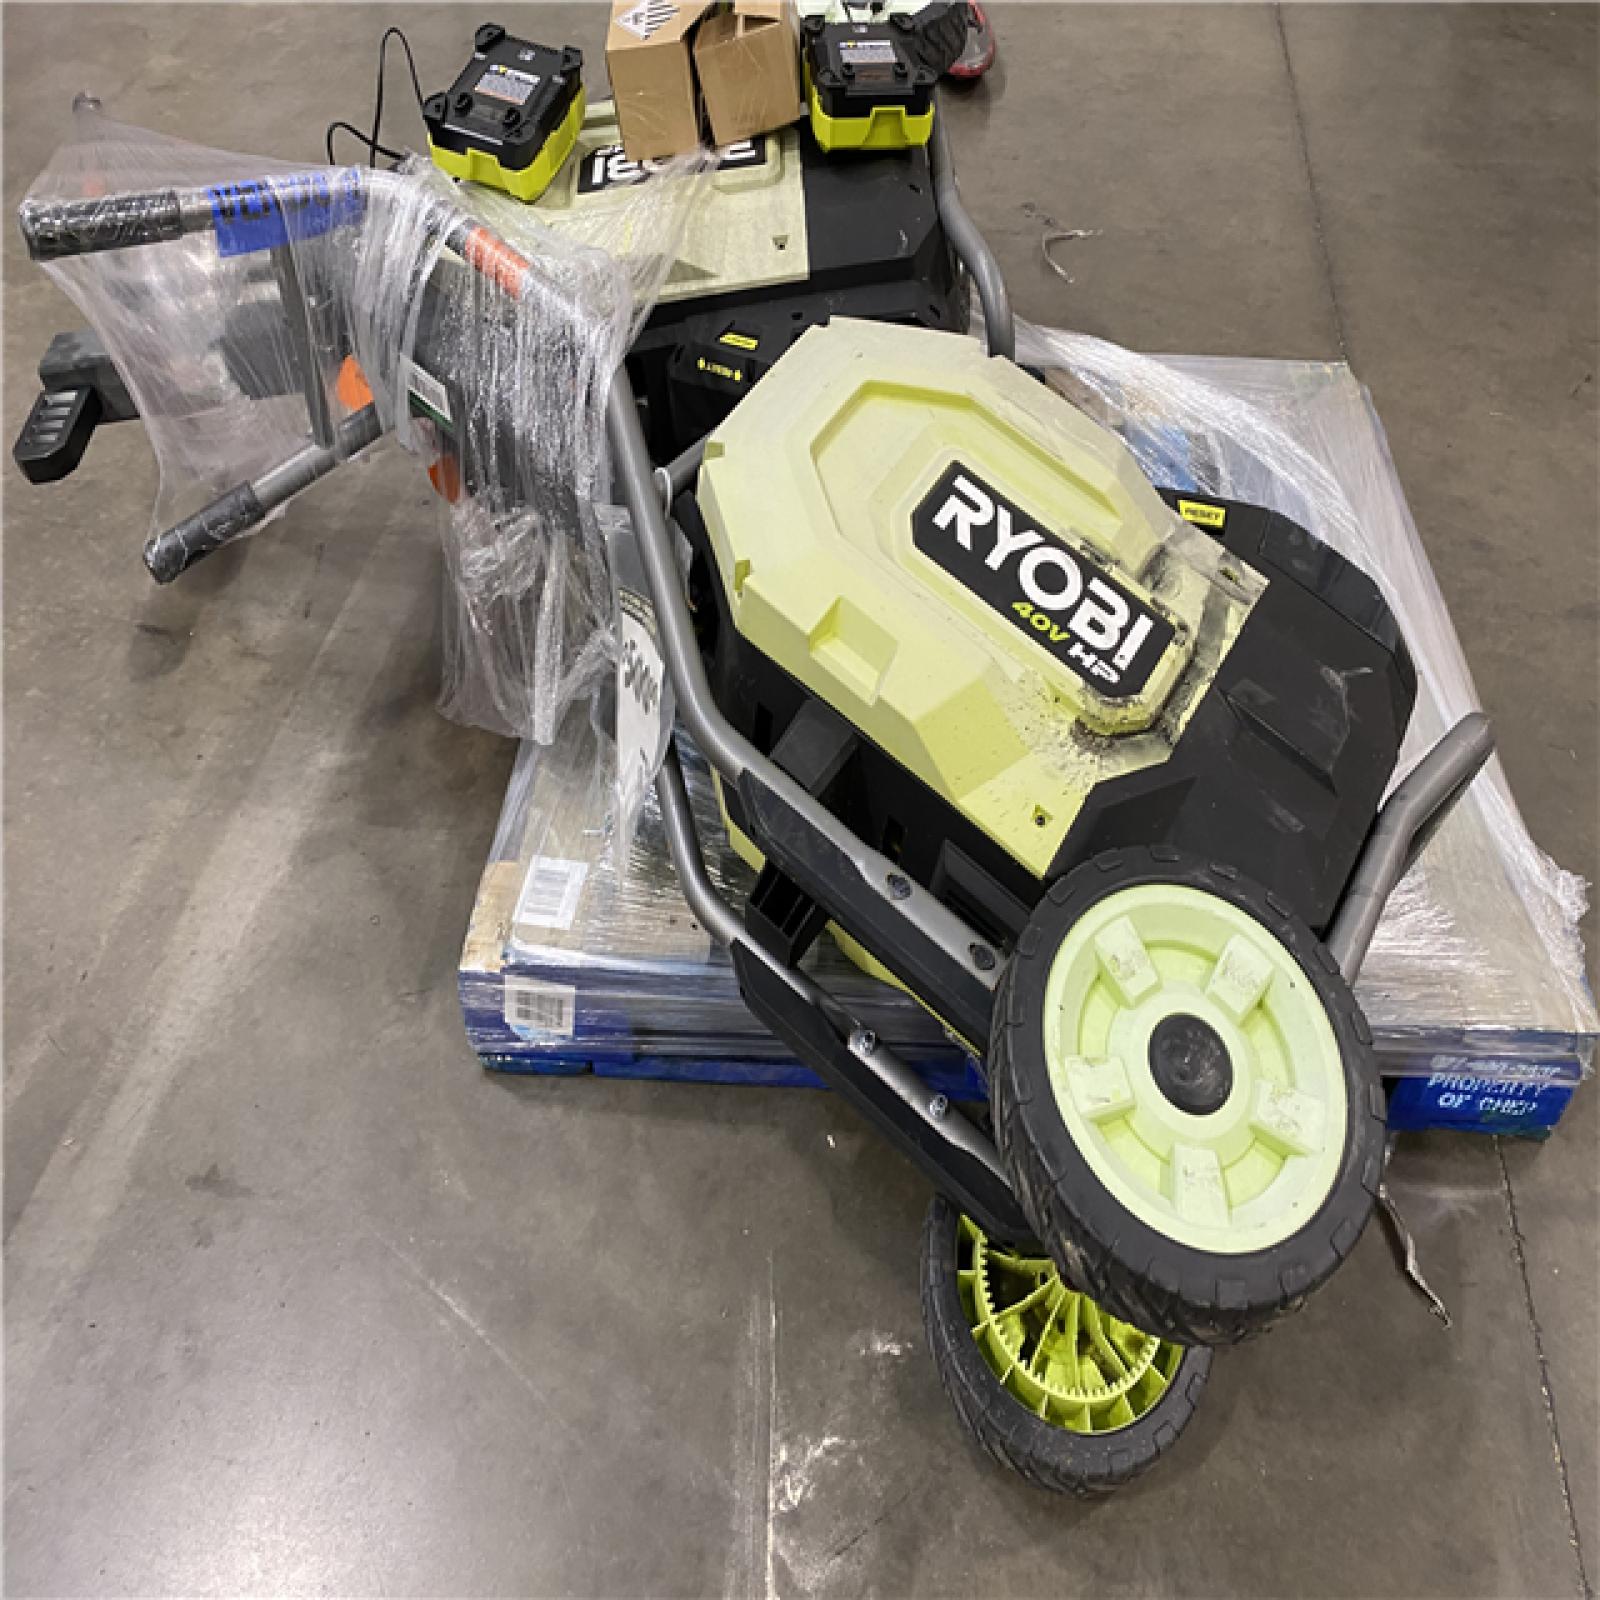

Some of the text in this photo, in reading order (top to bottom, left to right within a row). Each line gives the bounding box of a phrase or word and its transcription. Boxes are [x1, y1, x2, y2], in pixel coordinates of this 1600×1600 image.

[932, 475, 1153, 671] RYOBI
[1011, 601, 1121, 683] 40V HP
